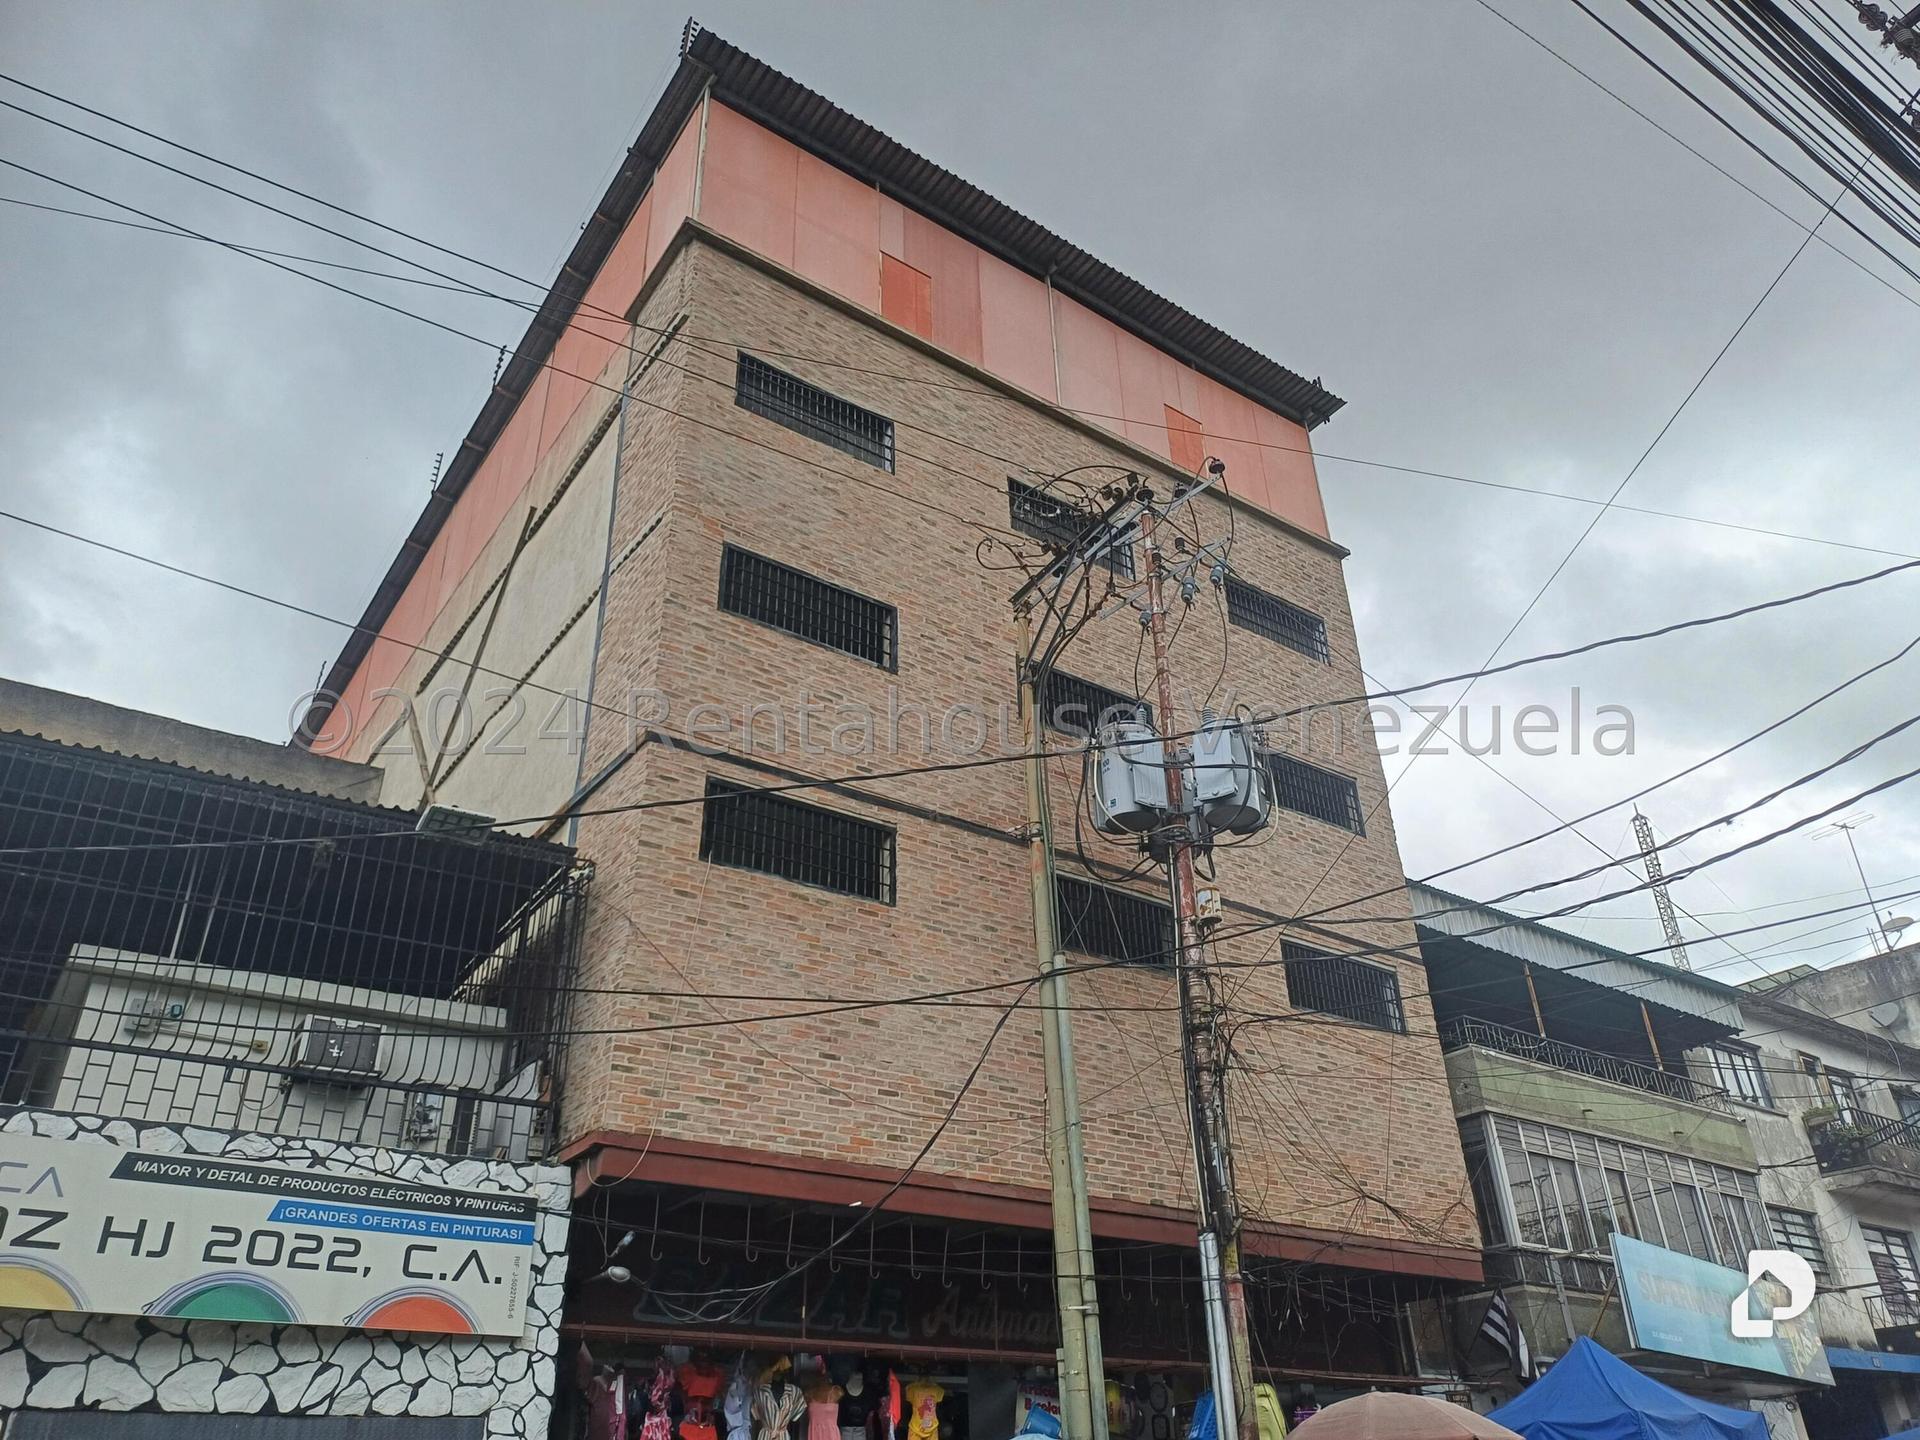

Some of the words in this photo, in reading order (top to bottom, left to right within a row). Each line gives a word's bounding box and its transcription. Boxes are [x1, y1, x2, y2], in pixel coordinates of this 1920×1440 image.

[133, 1160, 192, 1177] MAYOR
[195, 1167, 208, 1179] Y
[207, 1169, 255, 1184] DETAL
[257, 1174, 279, 1187] DE
[280, 1177, 368, 1197] PRODUCTOS
[369, 1186, 451, 1207] ELÉCTRICOS
[454, 1197, 464, 1207] Y
[464, 1198, 526, 1214] PINTURAS
[0, 1206, 69, 1250] Z
[96, 1215, 175, 1258] HJ
[202, 1225, 372, 1278] 2022,
[402, 1244, 502, 1285] C.A.
[279, 1207, 359, 1225] ¡GRANDES
[362, 1214, 427, 1231] OFERTAS
[430, 1221, 449, 1233] EN
[452, 1224, 523, 1240] PINTURAS!
